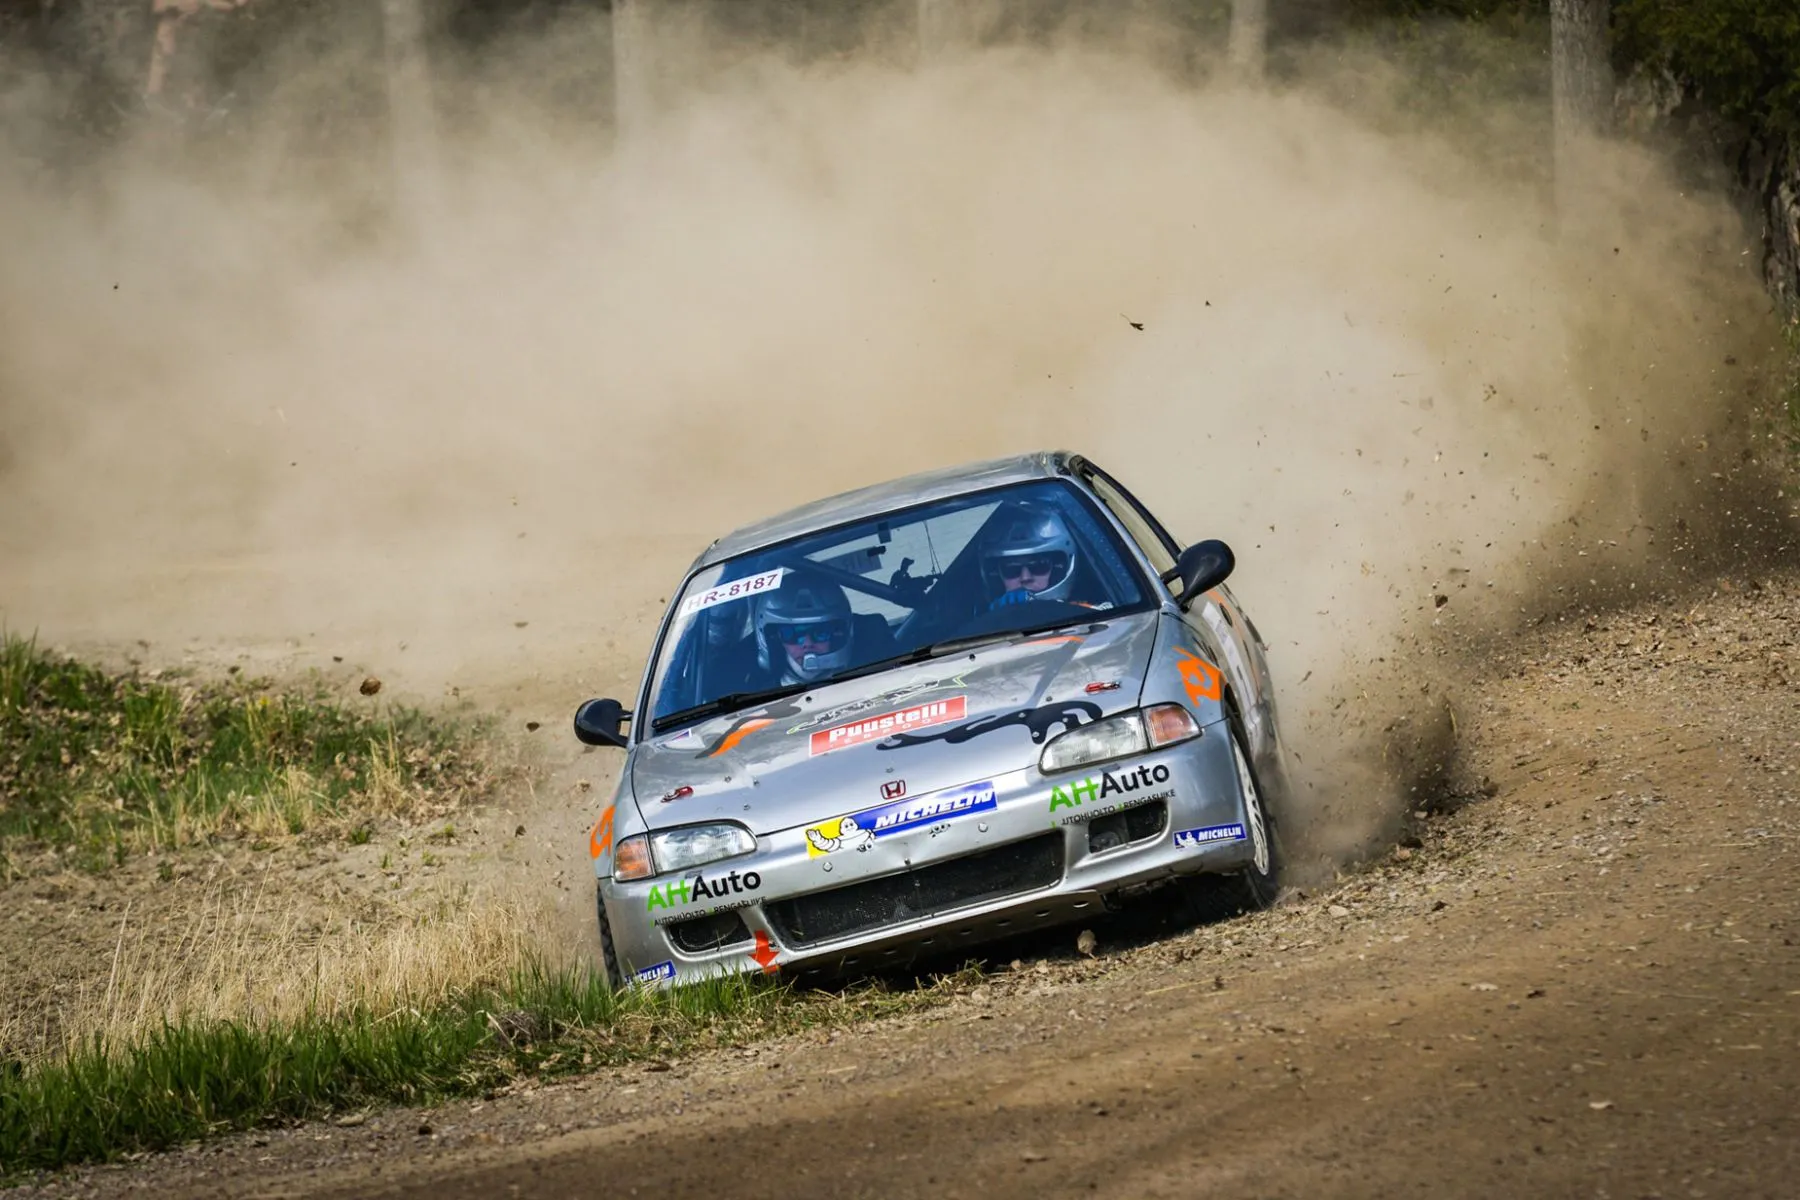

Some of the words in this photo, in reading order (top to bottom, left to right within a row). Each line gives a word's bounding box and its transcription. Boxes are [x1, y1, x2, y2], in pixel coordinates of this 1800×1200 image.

[687, 573, 778, 611] HR-8187
[828, 702, 946, 743] Puustelli
[875, 789, 994, 829] MICHELIN
[1198, 826, 1242, 841] MICHELIN
